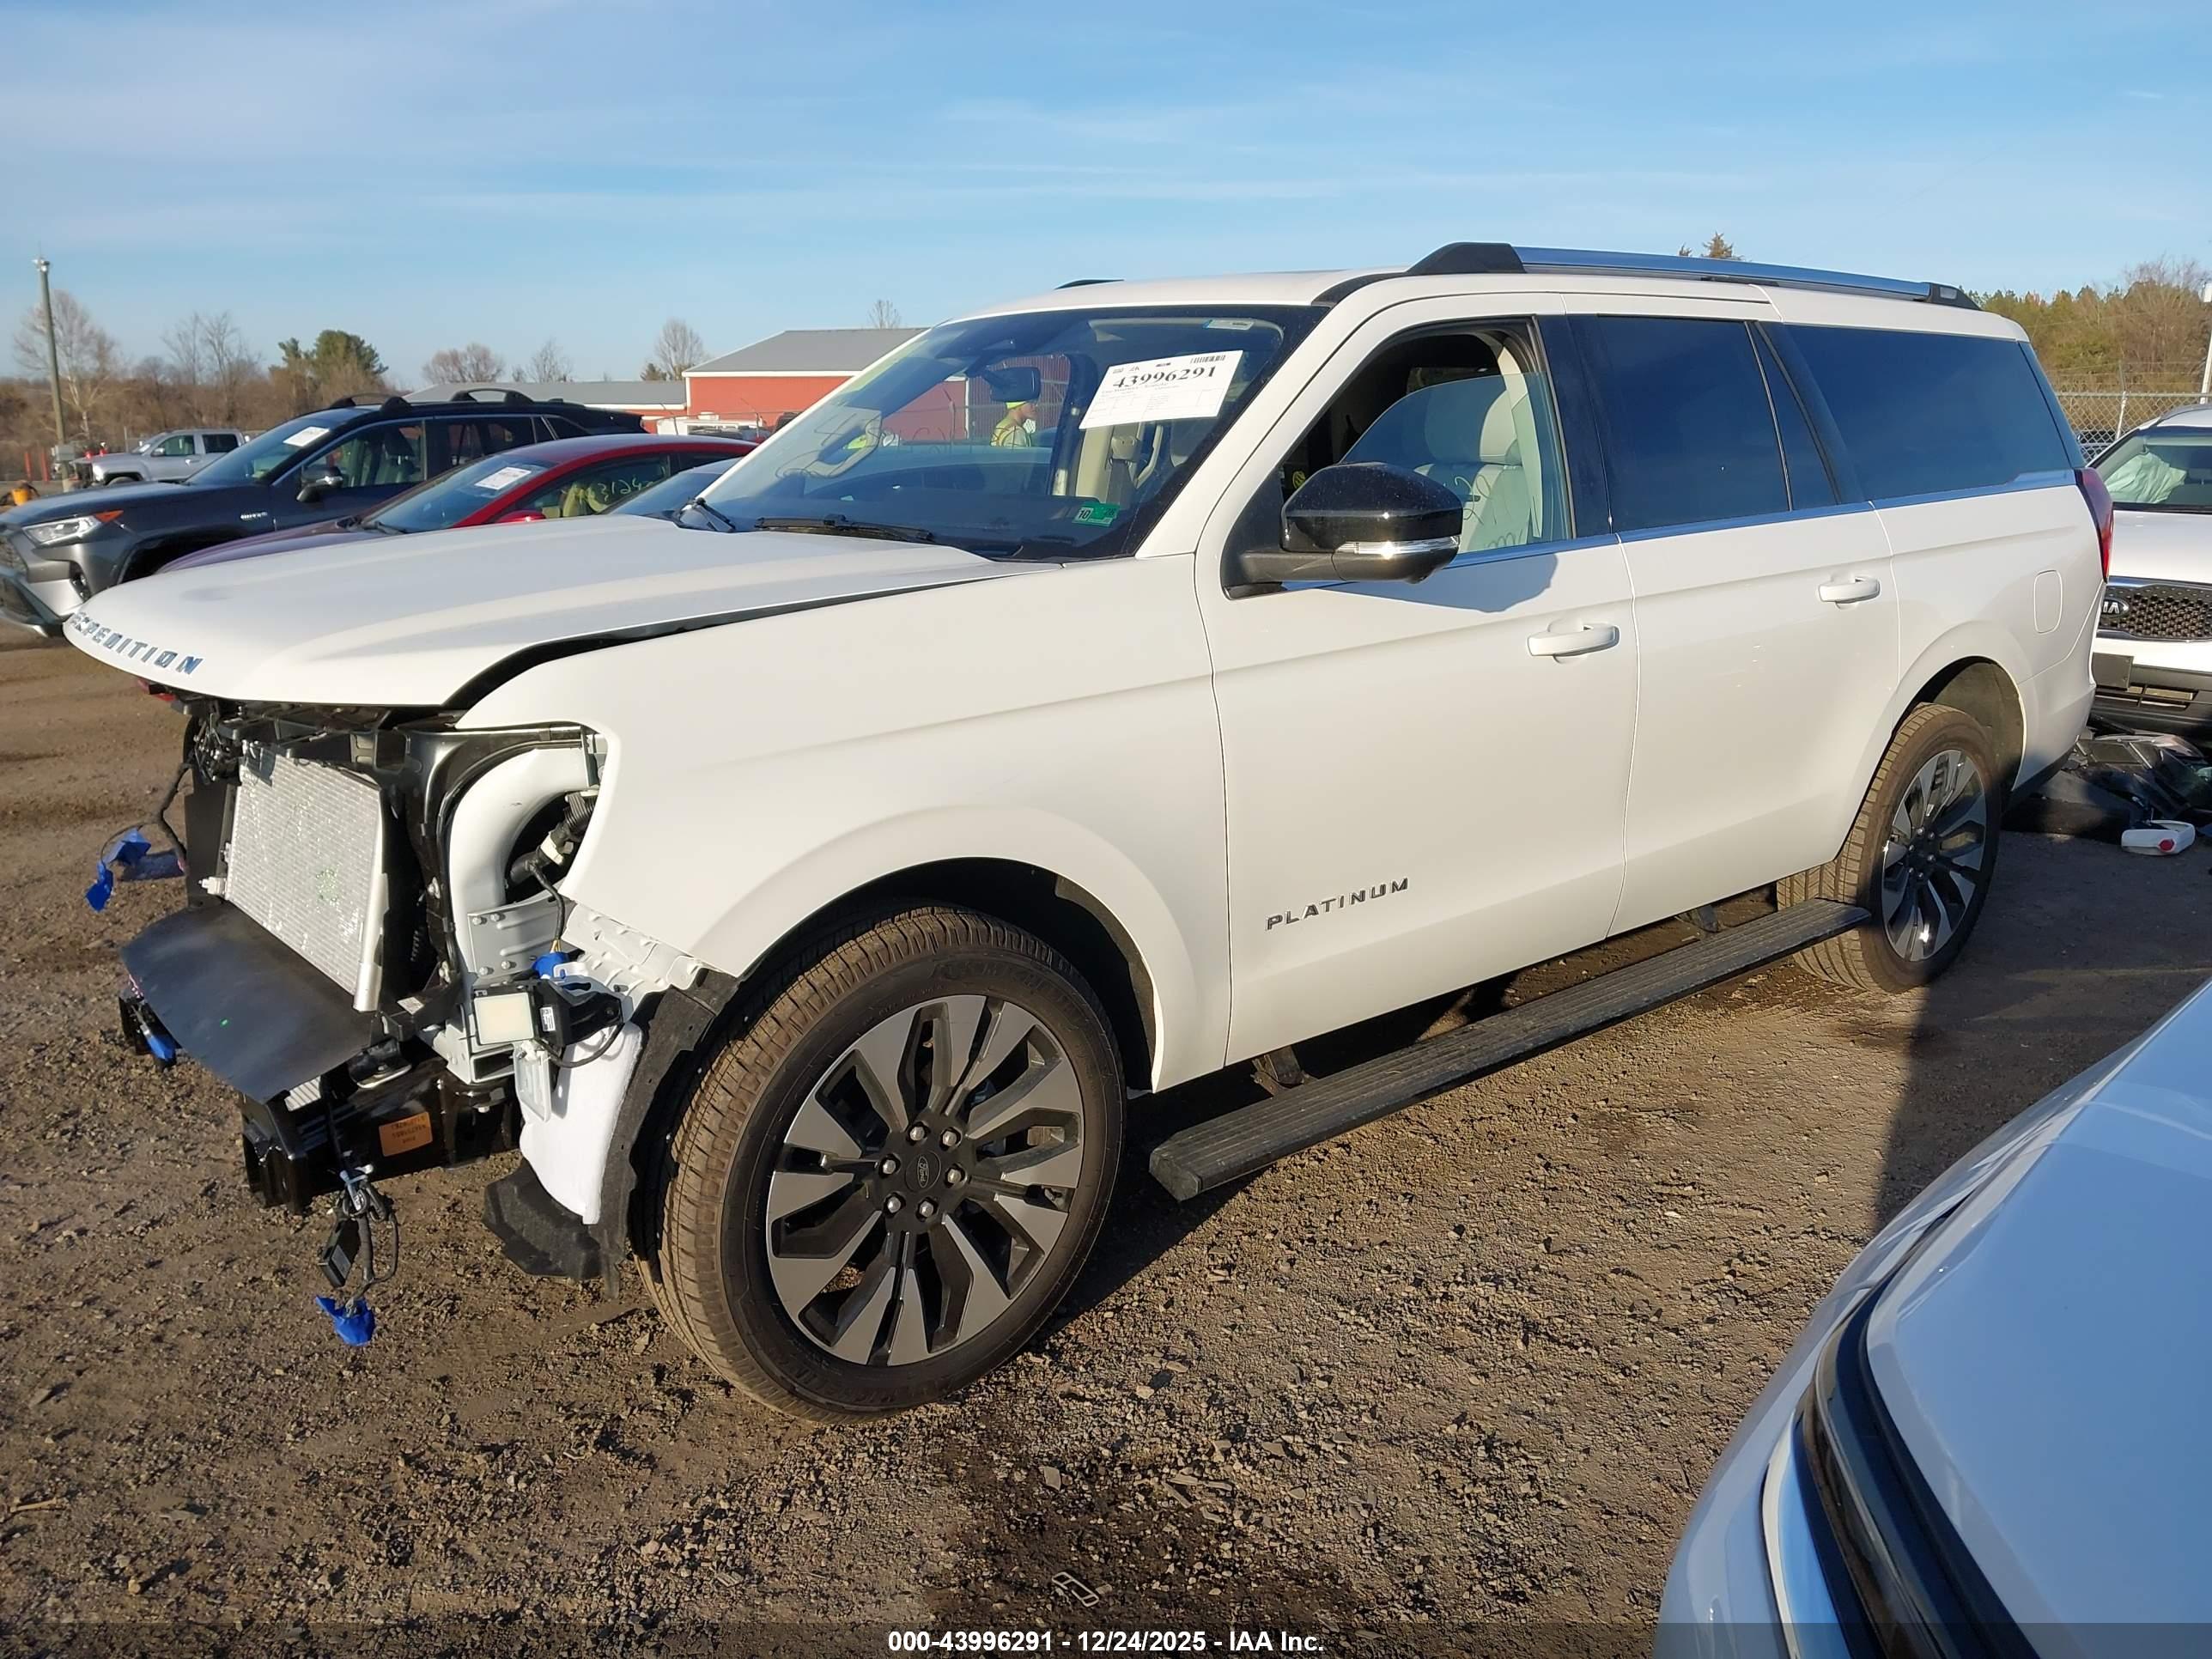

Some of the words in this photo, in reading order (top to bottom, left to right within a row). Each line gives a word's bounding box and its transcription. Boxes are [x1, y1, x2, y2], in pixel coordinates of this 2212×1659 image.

[1113, 365, 1216, 388] 43996291
[1079, 508, 1091, 520] 10
[70, 611, 204, 675] EXPEDITION
[1266, 877, 1409, 931] PLATINUM
